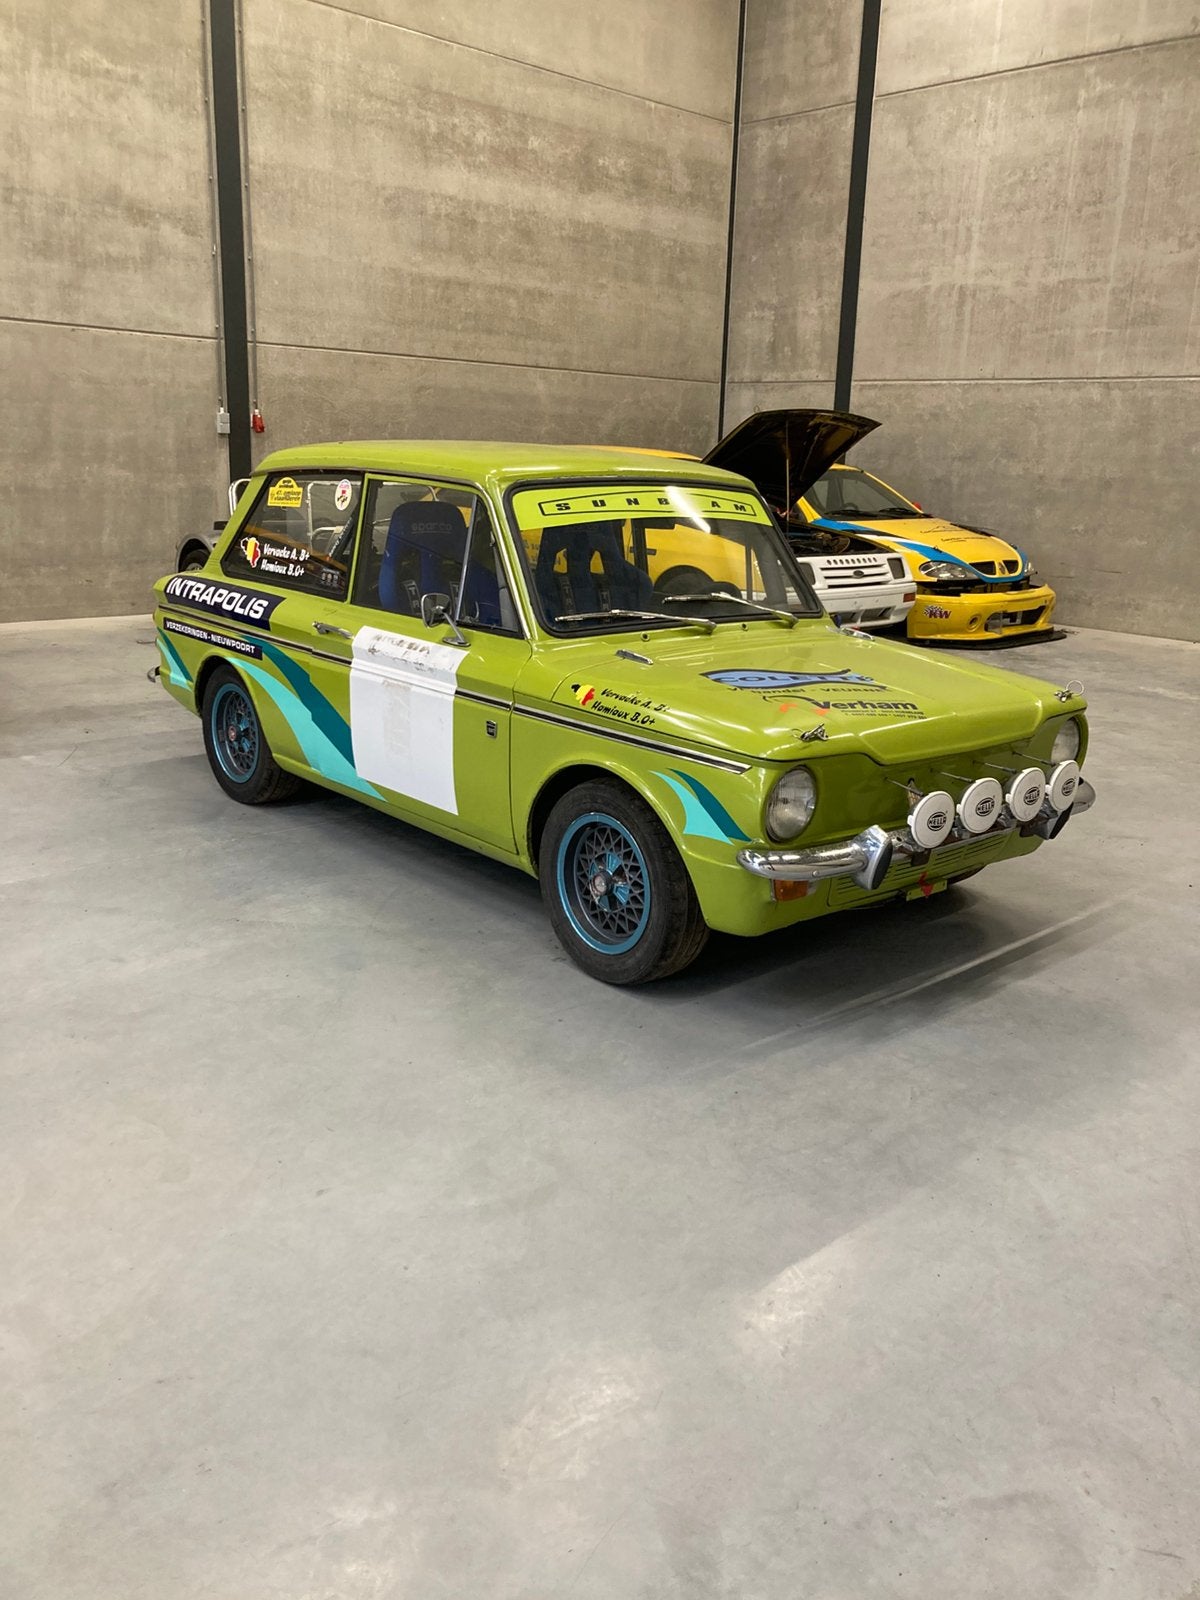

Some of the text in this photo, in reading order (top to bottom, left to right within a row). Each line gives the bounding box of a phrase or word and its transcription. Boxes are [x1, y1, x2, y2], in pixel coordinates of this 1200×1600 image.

[555, 497, 747, 512] SUNBAM
[290, 547, 298, 560] A.
[299, 548, 310, 562] B+
[165, 577, 269, 619] INTRAPOLIS
[811, 699, 919, 711] Verham
[976, 800, 995, 812] HELLA
[928, 814, 947, 827] HELLA
